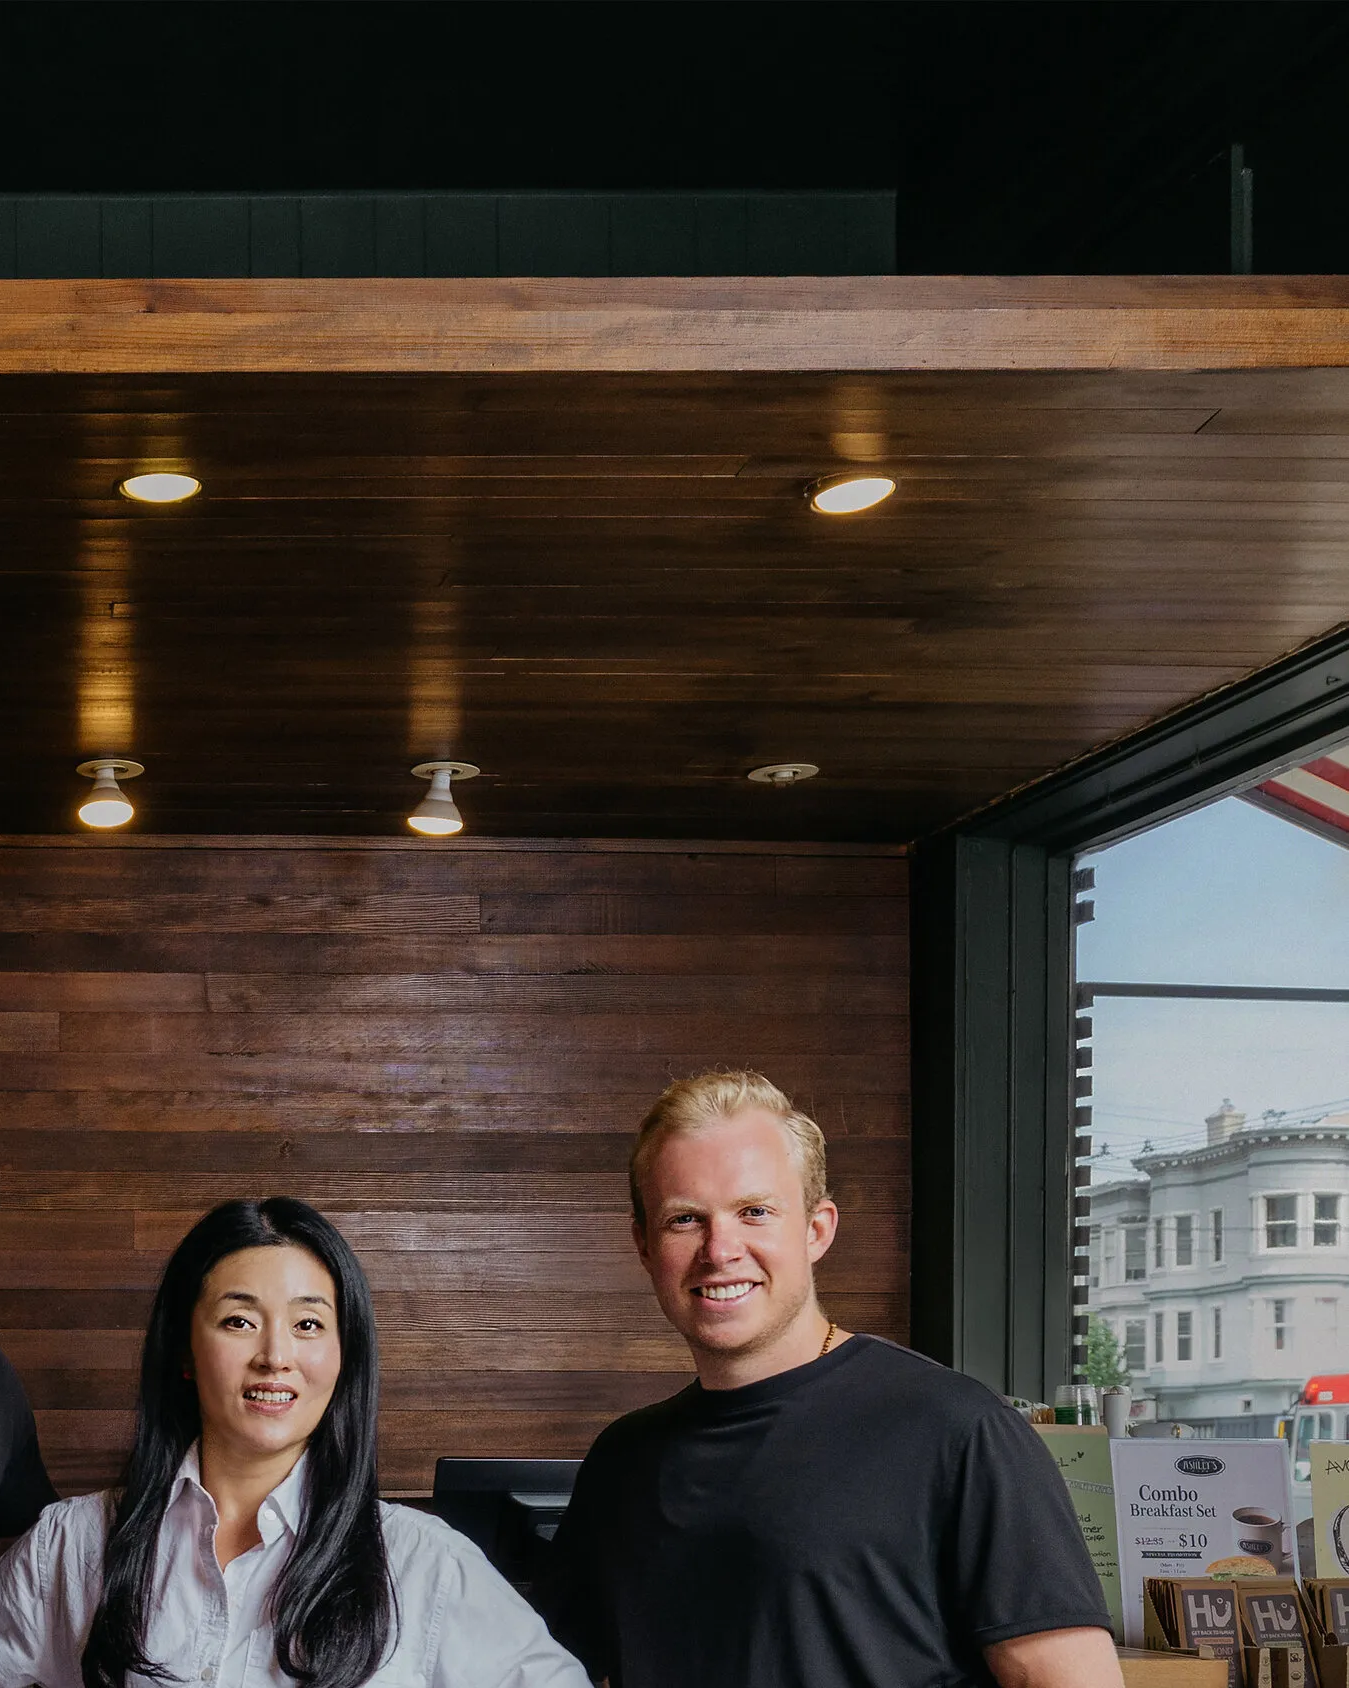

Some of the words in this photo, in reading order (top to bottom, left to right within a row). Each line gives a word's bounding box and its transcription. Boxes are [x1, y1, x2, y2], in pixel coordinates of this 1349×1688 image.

[1139, 1485, 1198, 1502] Combo
[1130, 1503, 1193, 1518] Breakfast
[1196, 1504, 1217, 1518] Set
[1179, 1533, 1208, 1548] $10
